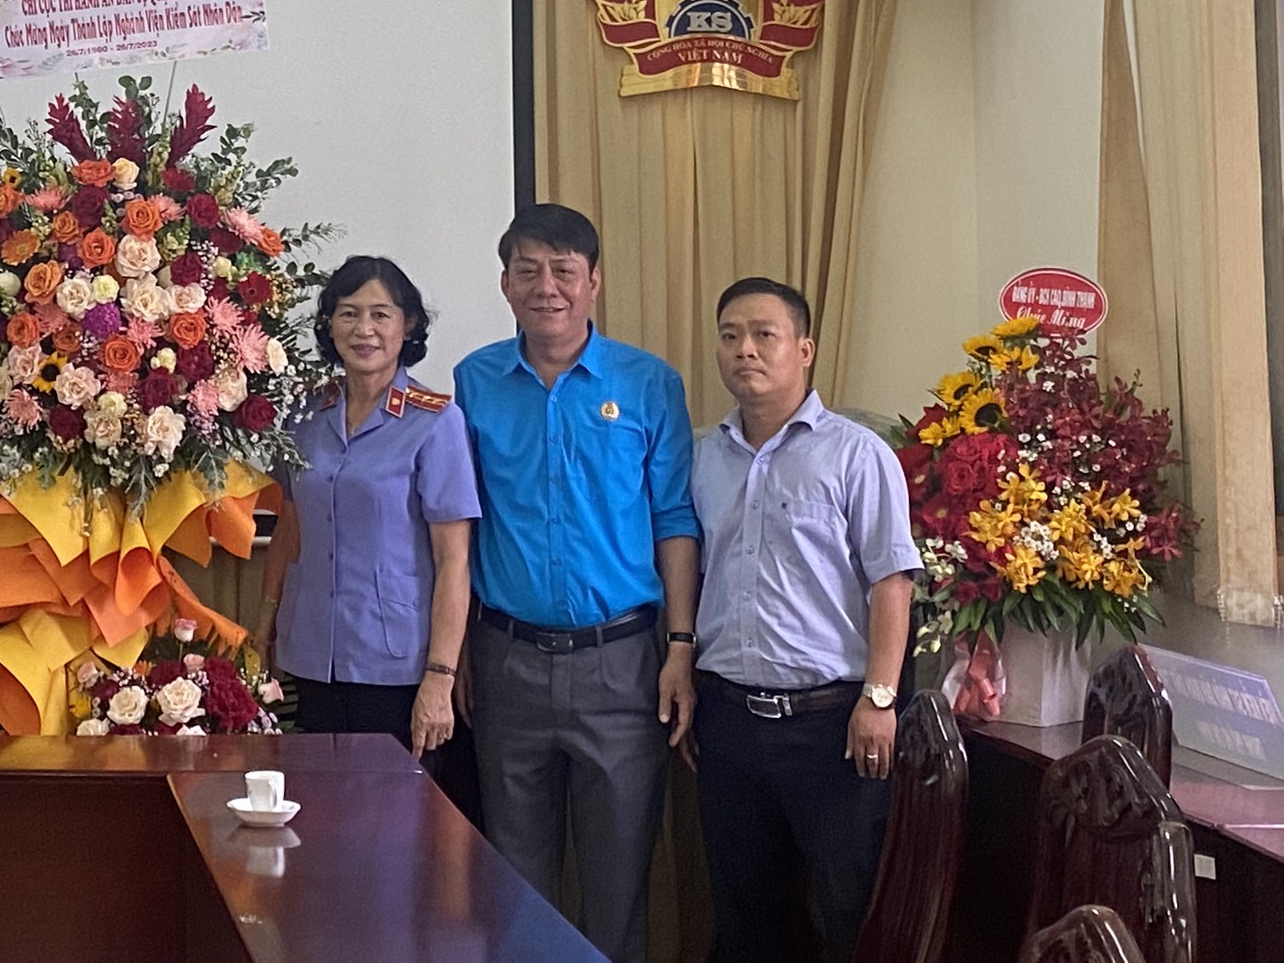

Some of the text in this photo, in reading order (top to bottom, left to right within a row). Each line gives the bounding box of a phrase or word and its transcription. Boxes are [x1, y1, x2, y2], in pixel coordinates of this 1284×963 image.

[686, 11, 733, 33] KS
[677, 48, 744, 64] VIỆT NAM
